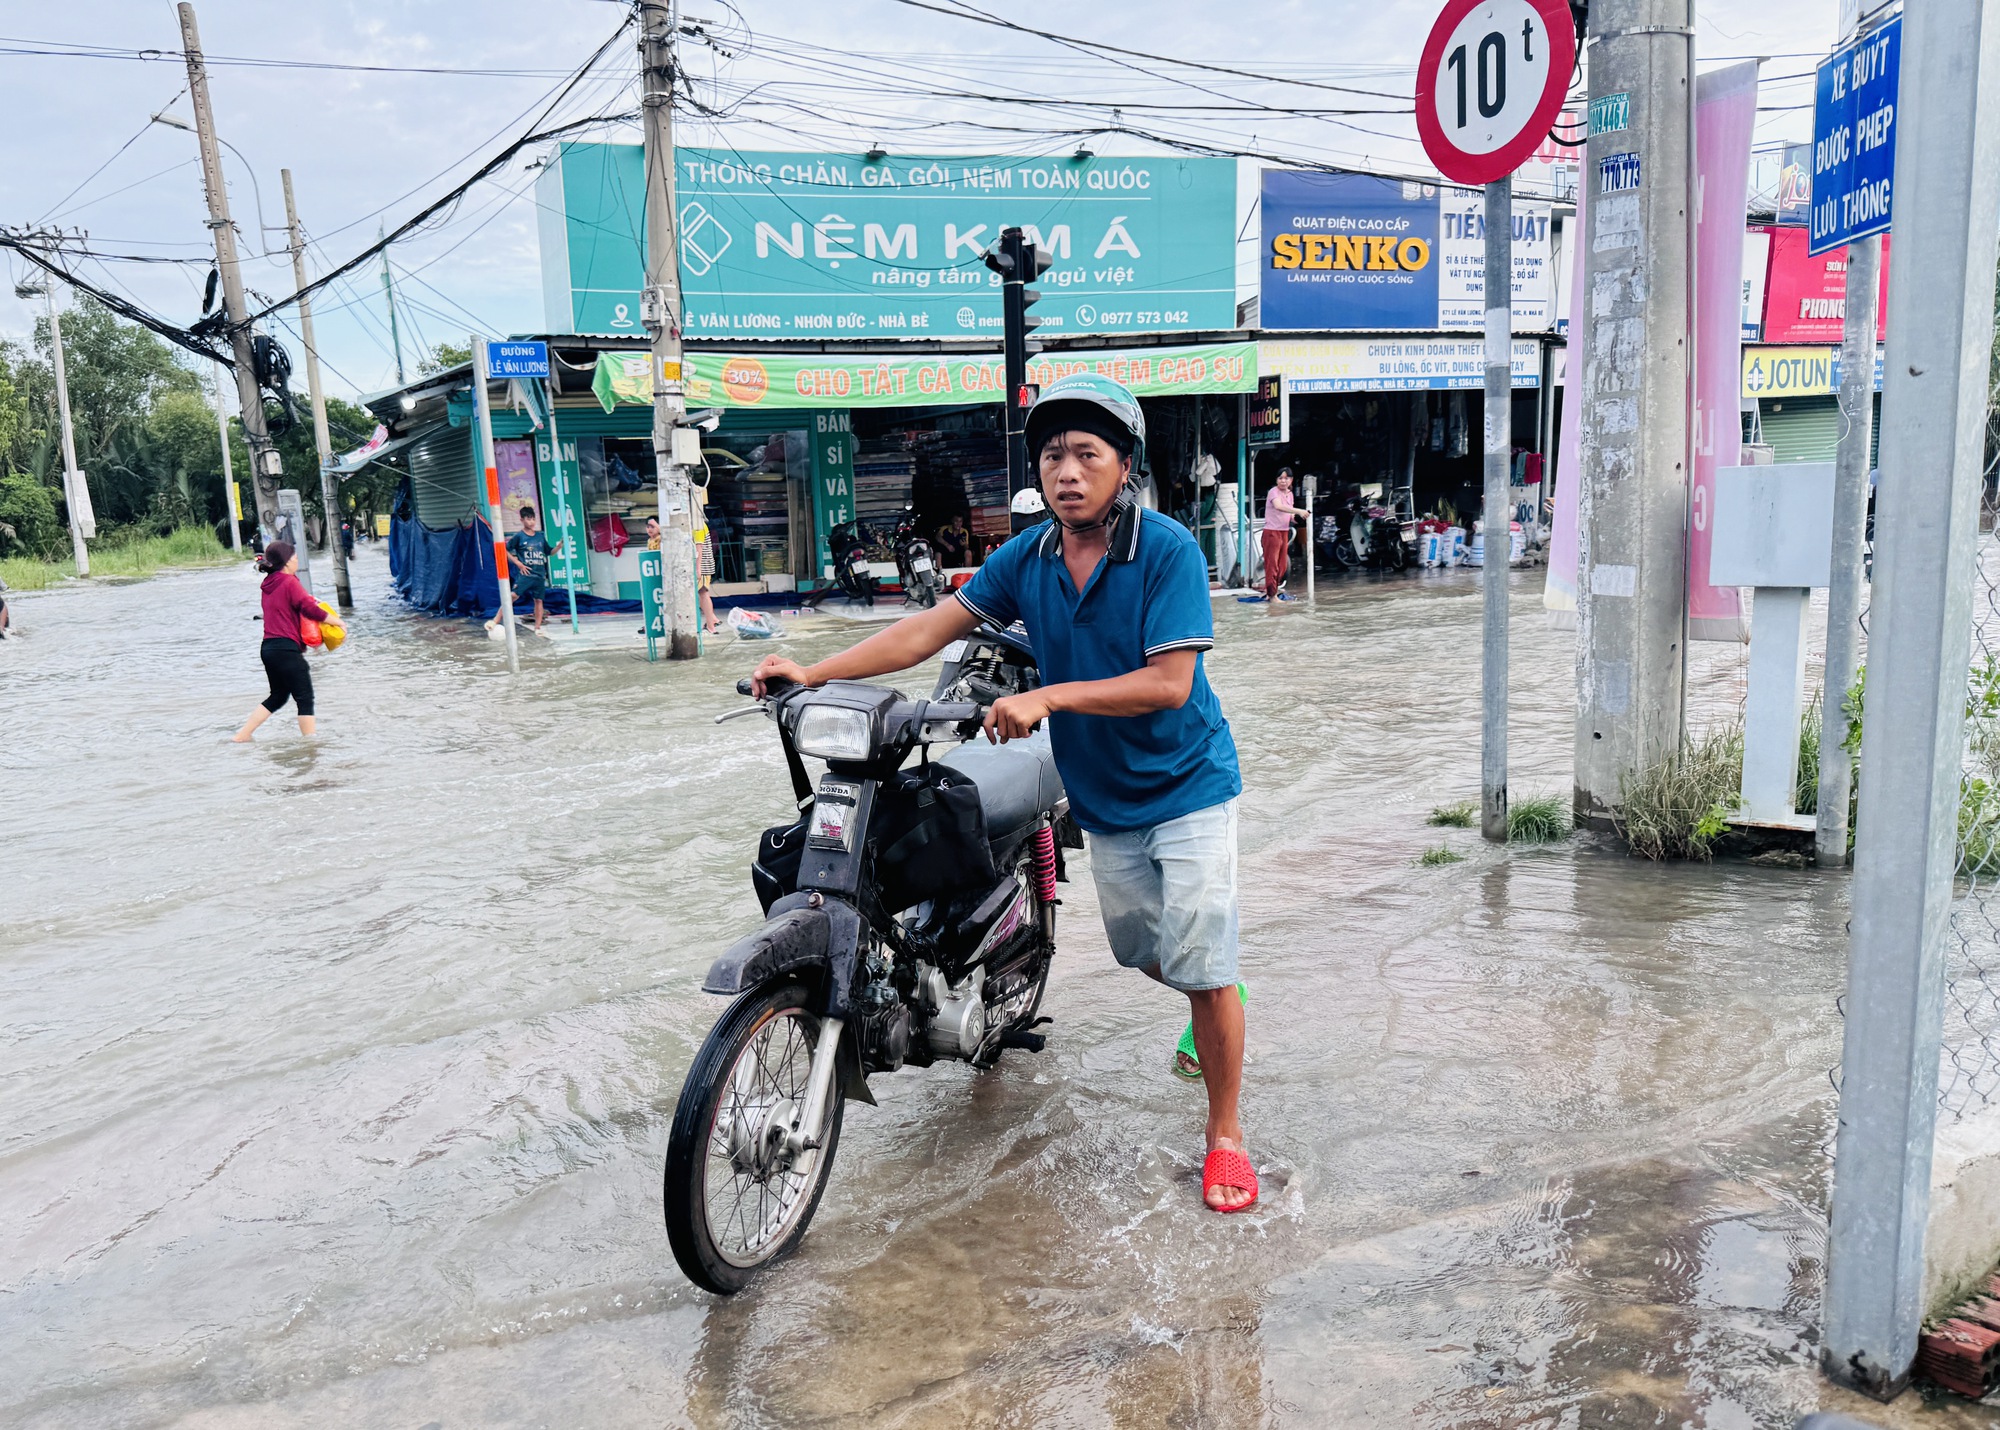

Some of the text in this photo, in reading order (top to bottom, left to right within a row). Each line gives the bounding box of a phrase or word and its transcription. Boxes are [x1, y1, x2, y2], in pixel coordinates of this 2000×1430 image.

[1447, 18, 1534, 129] 10 t
[1831, 31, 1890, 103] XE BUÝT
[1816, 98, 1894, 175] ĐƯỢC PHÉP
[778, 160, 853, 190] CHĂN,
[861, 166, 901, 189] GA,
[908, 162, 957, 191] GỐI,
[963, 165, 1012, 192] NỆM
[1018, 163, 1080, 190] TOÀN
[1086, 163, 1151, 191] QUỐC
[1814, 194, 1838, 240] LƯU
[1842, 178, 1891, 230] THÔNG
[1292, 215, 1410, 231] QUẠT ĐIỆN CAO CẤP
[1511, 209, 1549, 248] UẬT
[755, 213, 918, 269] NỆM
[1093, 215, 1142, 260] Á
[1272, 233, 1431, 271] SENKO
[1514, 258, 1543, 268] GIA DỤNG
[872, 268, 931, 288] nâng
[1043, 266, 1135, 287] ngủ việt
[1287, 272, 1414, 285] LÀM MÁT CHO CUỘC SỐNG
[1466, 283, 1483, 294] DỤNG
[699, 312, 730, 328] VĂN
[733, 313, 781, 329] LƯƠNG
[794, 312, 835, 328] NHƠN
[836, 311, 866, 328] ĐỨC
[879, 311, 907, 328] NHÀ
[910, 311, 930, 328] BÈ
[1101, 311, 1189, 325] 0977 573 042
[501, 345, 536, 356] ĐƯỜNG
[1368, 341, 1480, 356] CHUYÊN KINH DOANH THIẾT
[1513, 342, 1535, 355] NƯỚC
[491, 359, 548, 373] LÊ VĂN LƯƠNG
[727, 368, 764, 385] 30%
[795, 368, 850, 397] CHO
[857, 362, 910, 396] TẤT
[917, 359, 952, 394] CẢ
[1158, 357, 1206, 384] CAO
[1212, 355, 1244, 382] SU
[1379, 362, 1391, 374] BU
[1393, 361, 1418, 375] LÔNG,
[1420, 359, 1432, 373] ỐC
[1434, 360, 1450, 374] VÍT,
[1452, 361, 1475, 375] DỤNG
[1767, 358, 1827, 390] JOTUN
[1051, 382, 1097, 393] HONDA
[816, 411, 850, 432] BÁN
[1250, 405, 1280, 427] NƯỚC
[827, 441, 844, 465] SỈ
[826, 473, 848, 496] VÀ
[829, 504, 847, 528] LẺ
[820, 786, 849, 795] HONDA
